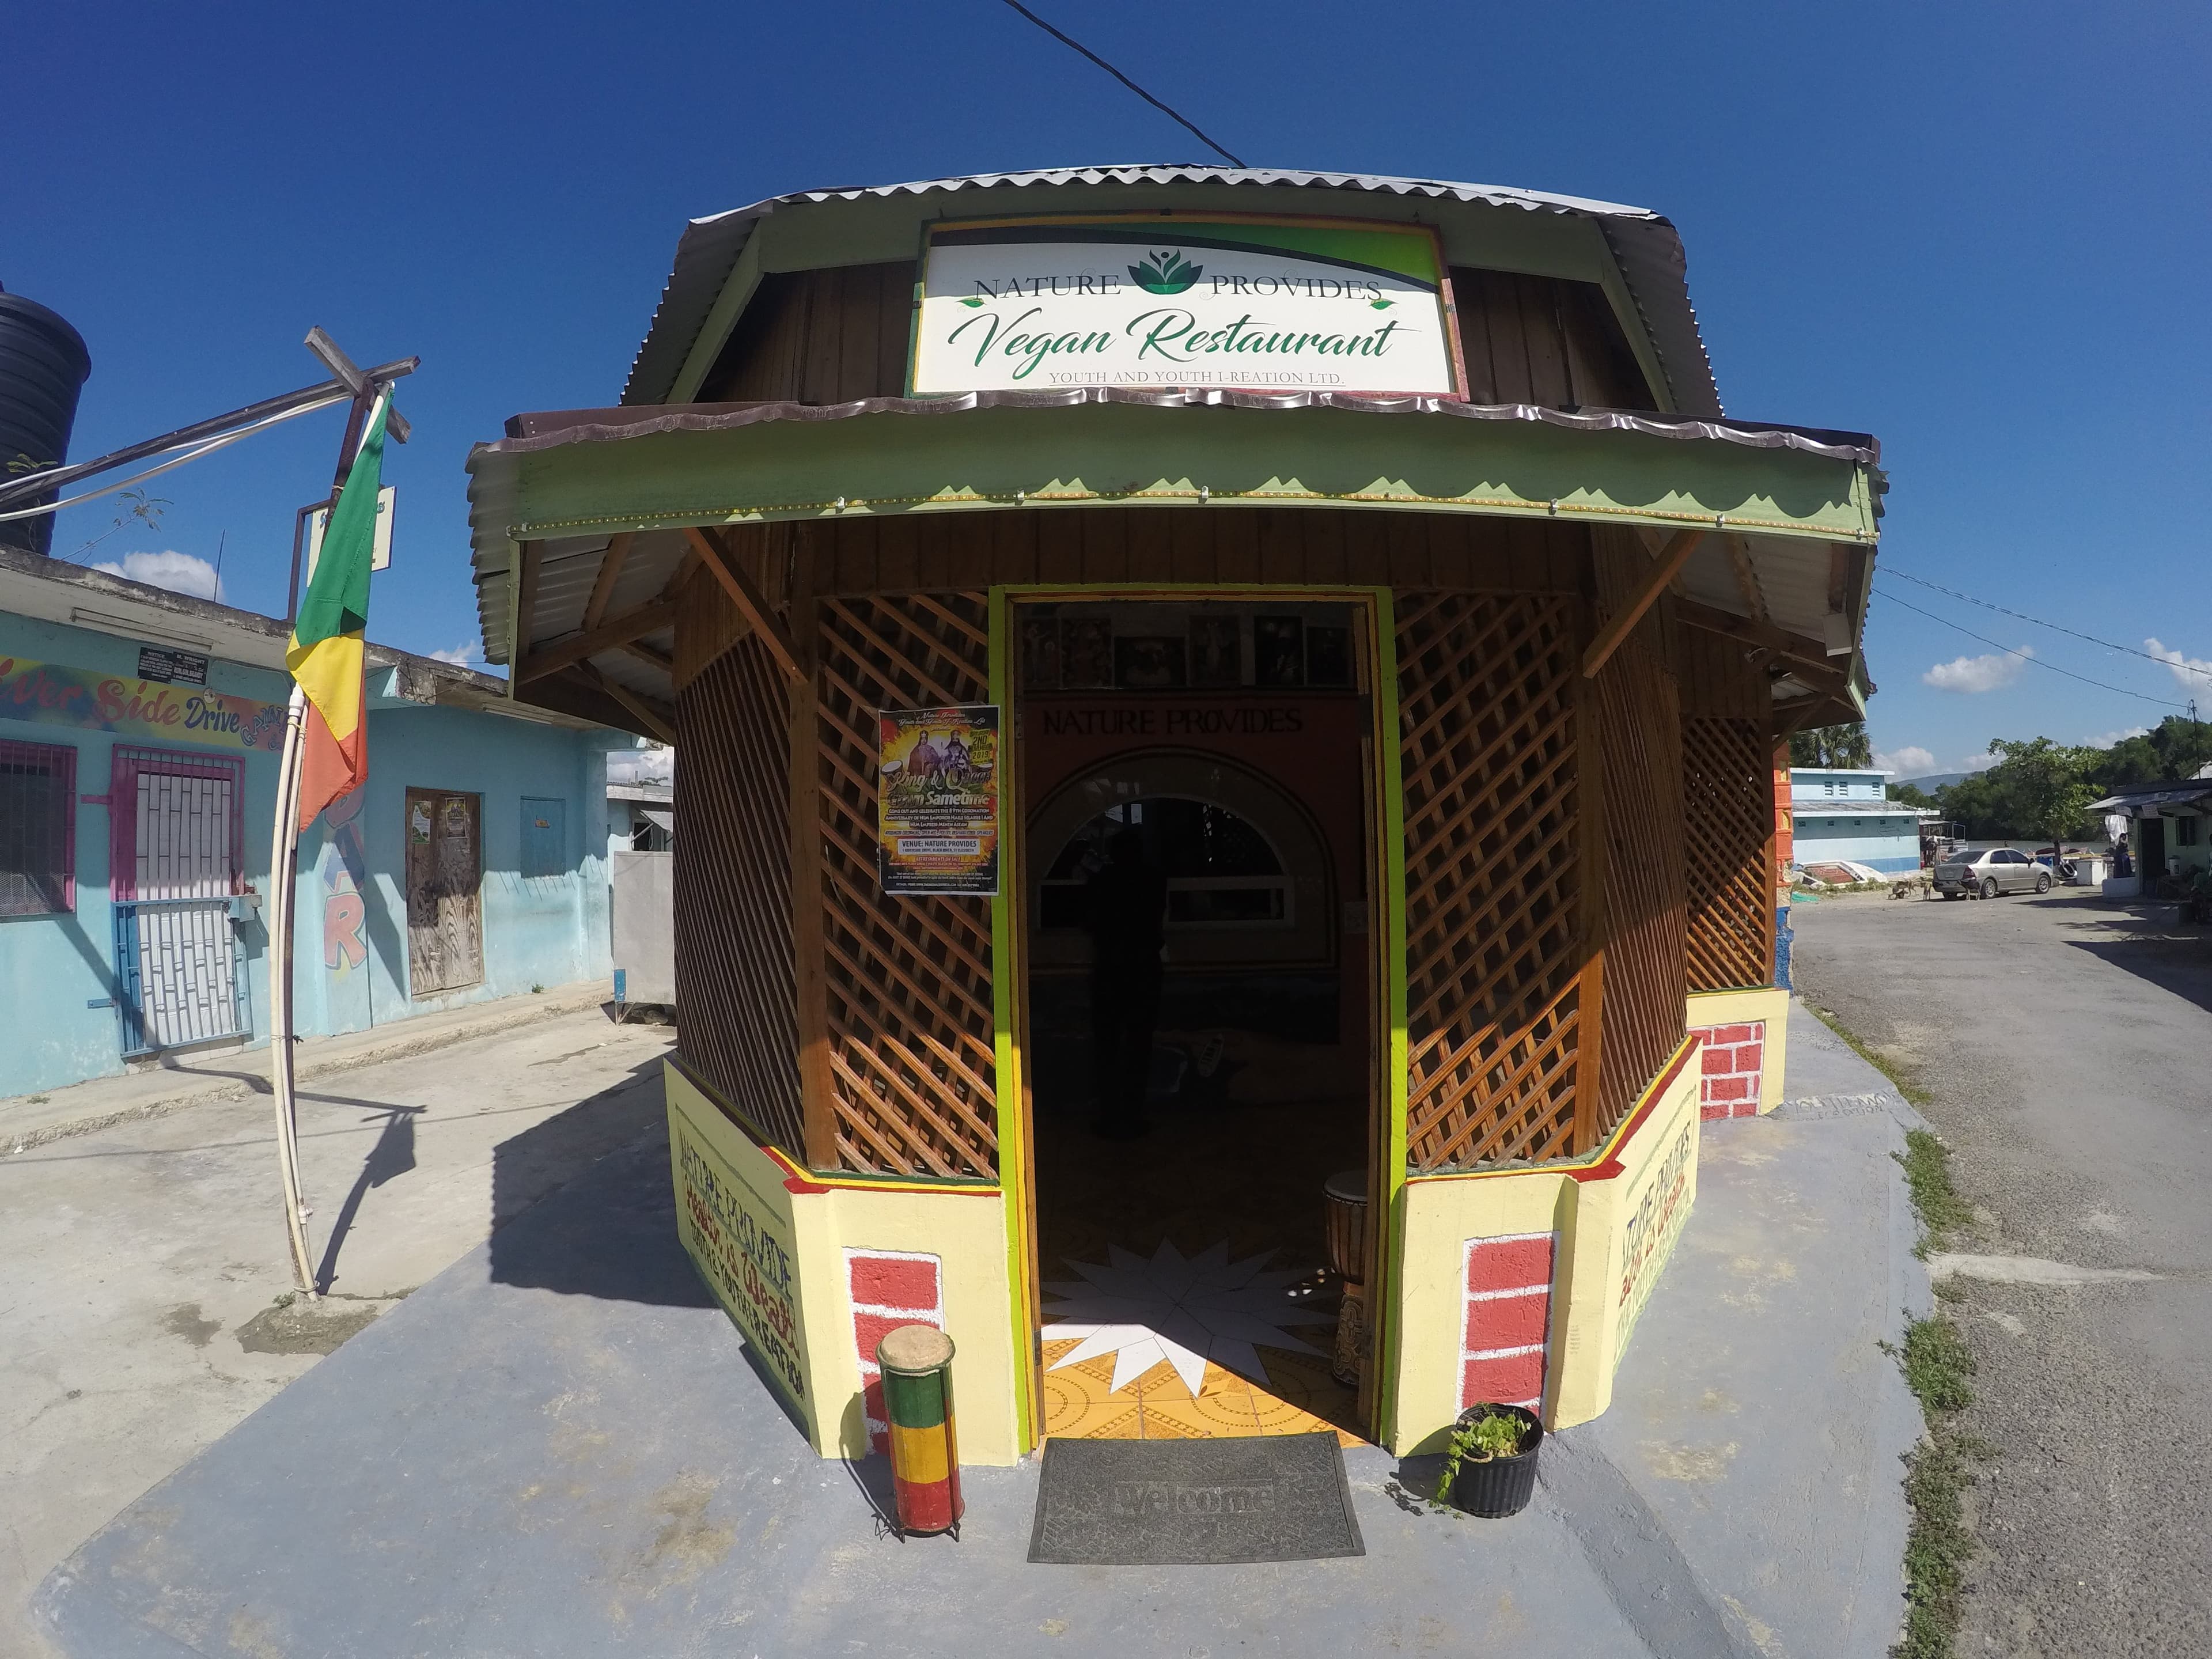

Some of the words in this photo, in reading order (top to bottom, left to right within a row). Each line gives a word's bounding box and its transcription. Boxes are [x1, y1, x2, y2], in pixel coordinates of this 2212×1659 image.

[974, 274, 1121, 302] NATURE
[1211, 274, 1382, 301] PROVIDES
[947, 307, 1116, 380] Vegan
[1126, 308, 1422, 362] Restaurant
[1049, 372, 1107, 384] YOUTH
[1114, 372, 1149, 382] AND
[1155, 372, 1212, 382] YOUTH
[1218, 372, 1305, 383] I-REATION
[1309, 373, 1346, 384] LTD.
[93, 680, 180, 725] Side
[184, 696, 240, 733] Drive
[1043, 710, 1157, 736] NATURE
[1166, 708, 1302, 734] PROVIDES
[973, 736, 987, 745] 2ND
[972, 751, 988, 759] 2019
[887, 772, 927, 793] King
[931, 770, 942, 790] &
